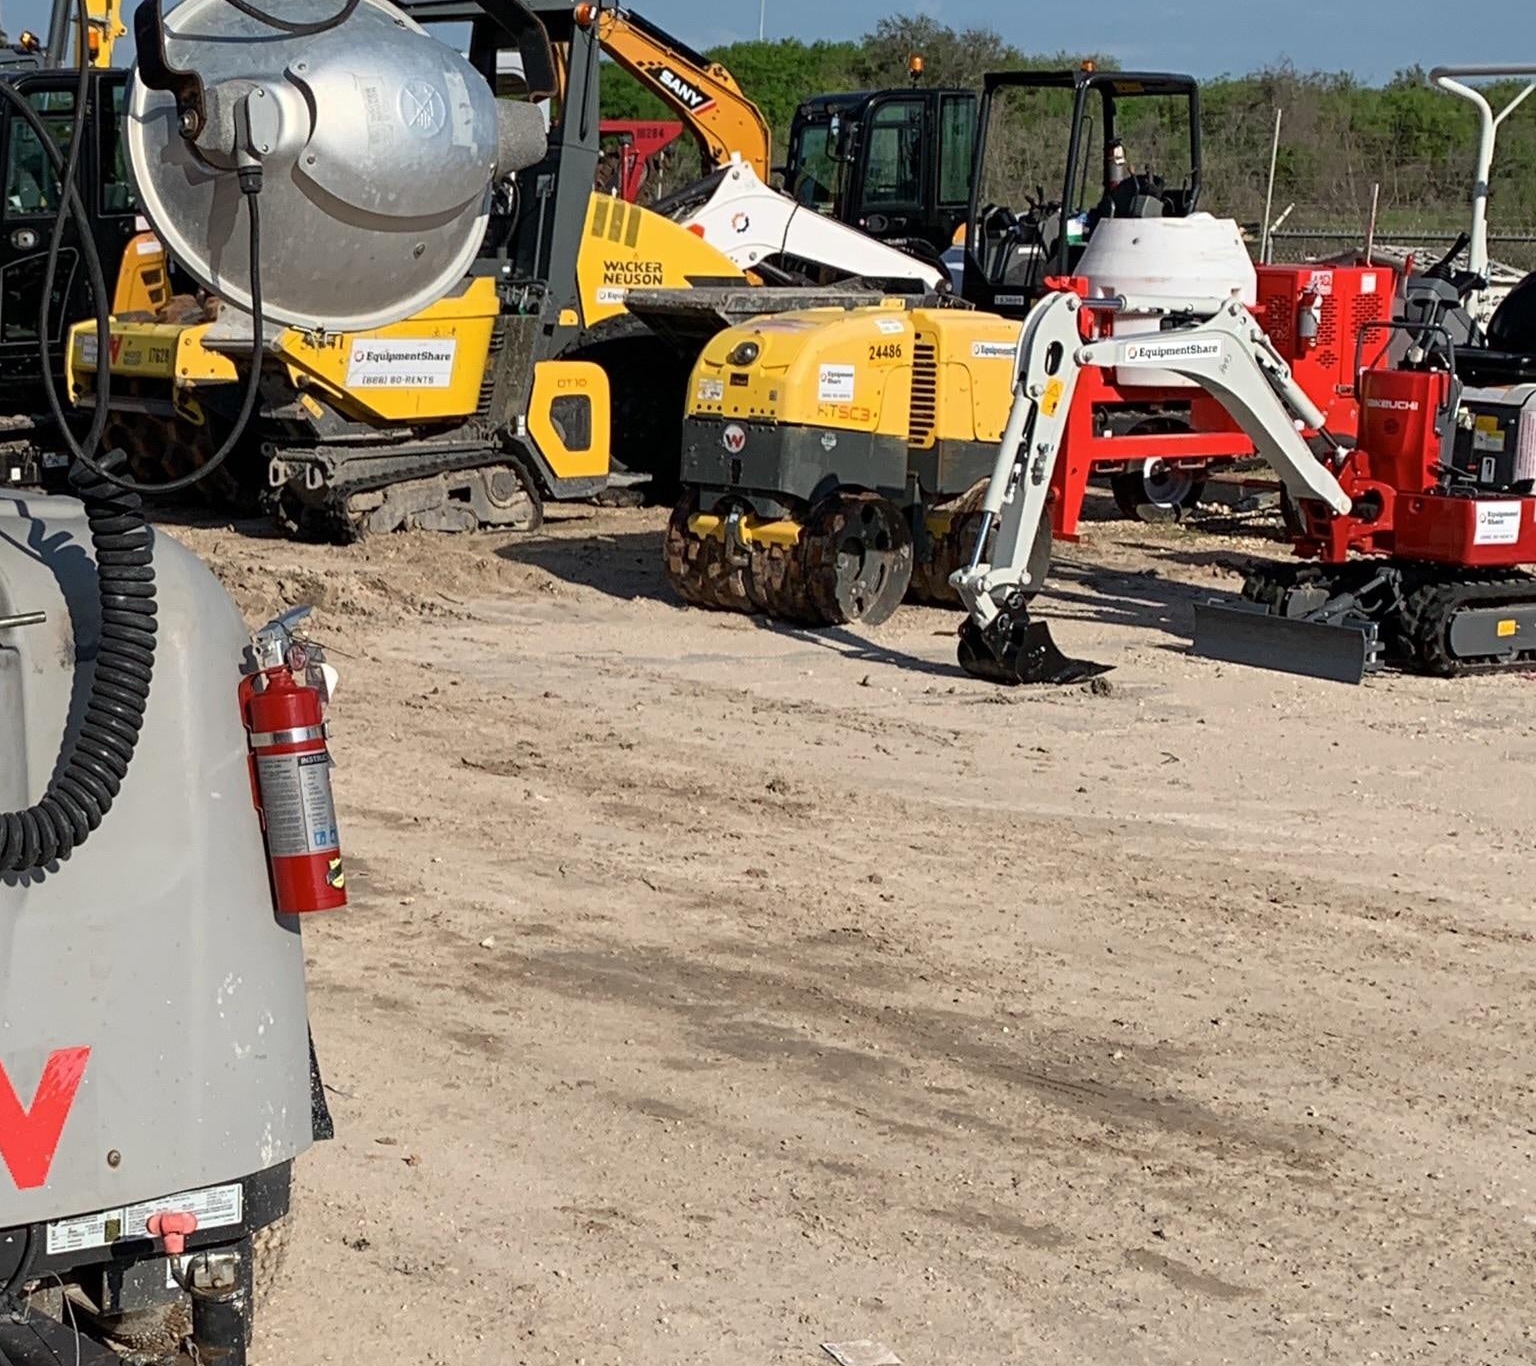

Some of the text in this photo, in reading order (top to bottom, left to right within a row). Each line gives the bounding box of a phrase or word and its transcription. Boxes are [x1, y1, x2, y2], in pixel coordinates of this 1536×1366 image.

[658, 69, 704, 107] SANY
[603, 260, 664, 274] WACKER
[603, 273, 664, 286] NEUSON
[366, 351, 451, 364] EquipmentShare
[868, 344, 902, 361] 24486
[1138, 344, 1219, 359] EquipmentShare
